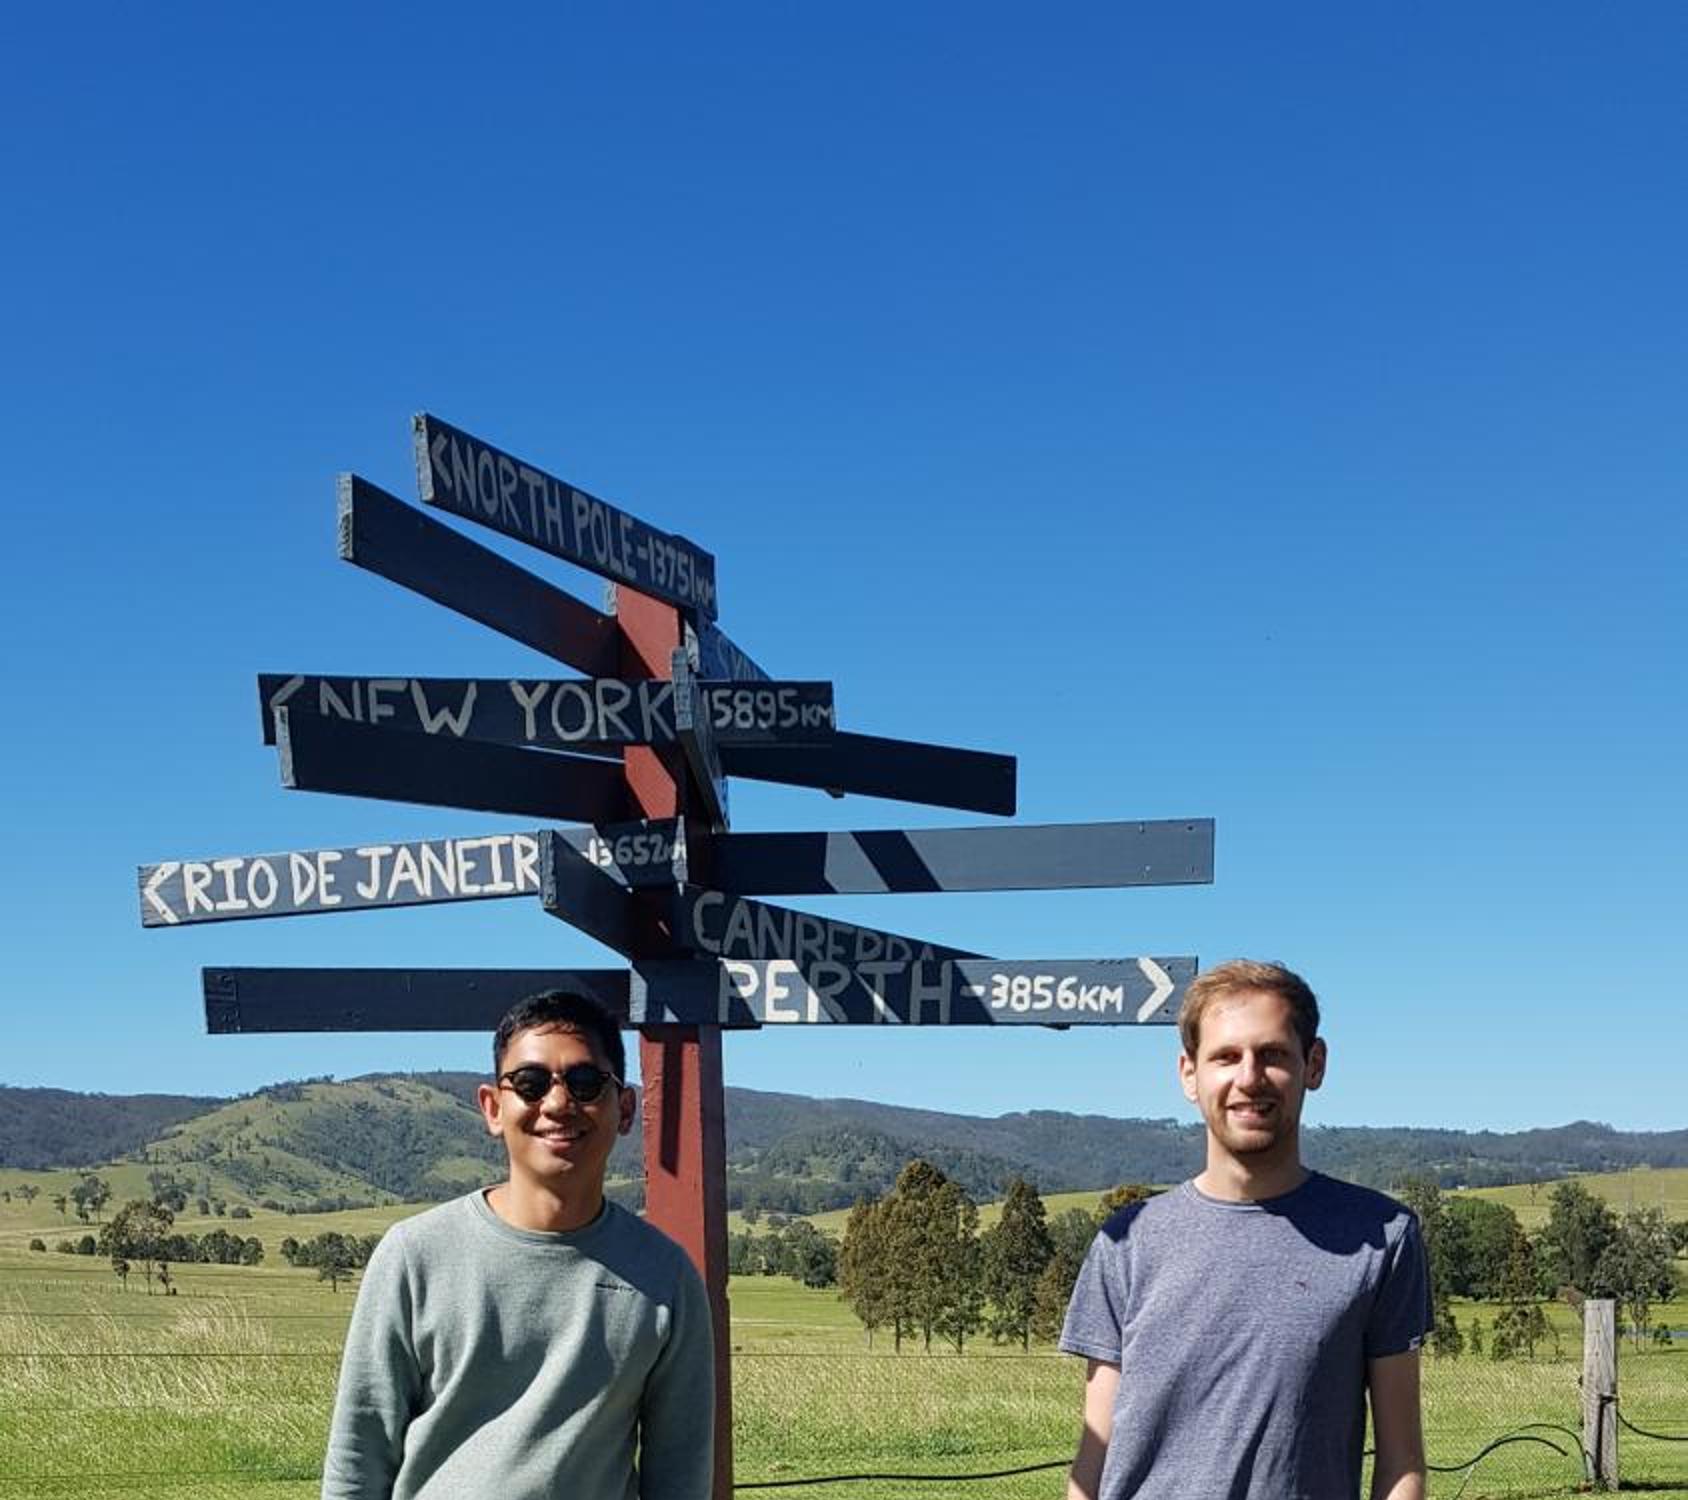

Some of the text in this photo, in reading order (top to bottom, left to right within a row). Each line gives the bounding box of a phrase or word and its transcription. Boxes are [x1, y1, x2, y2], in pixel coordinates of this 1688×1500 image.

[450, 435, 564, 547] NORTH
[510, 680, 676, 742] YORK
[183, 858, 279, 914] RIO
[289, 851, 343, 906] DE
[355, 834, 542, 899] JANEIR
